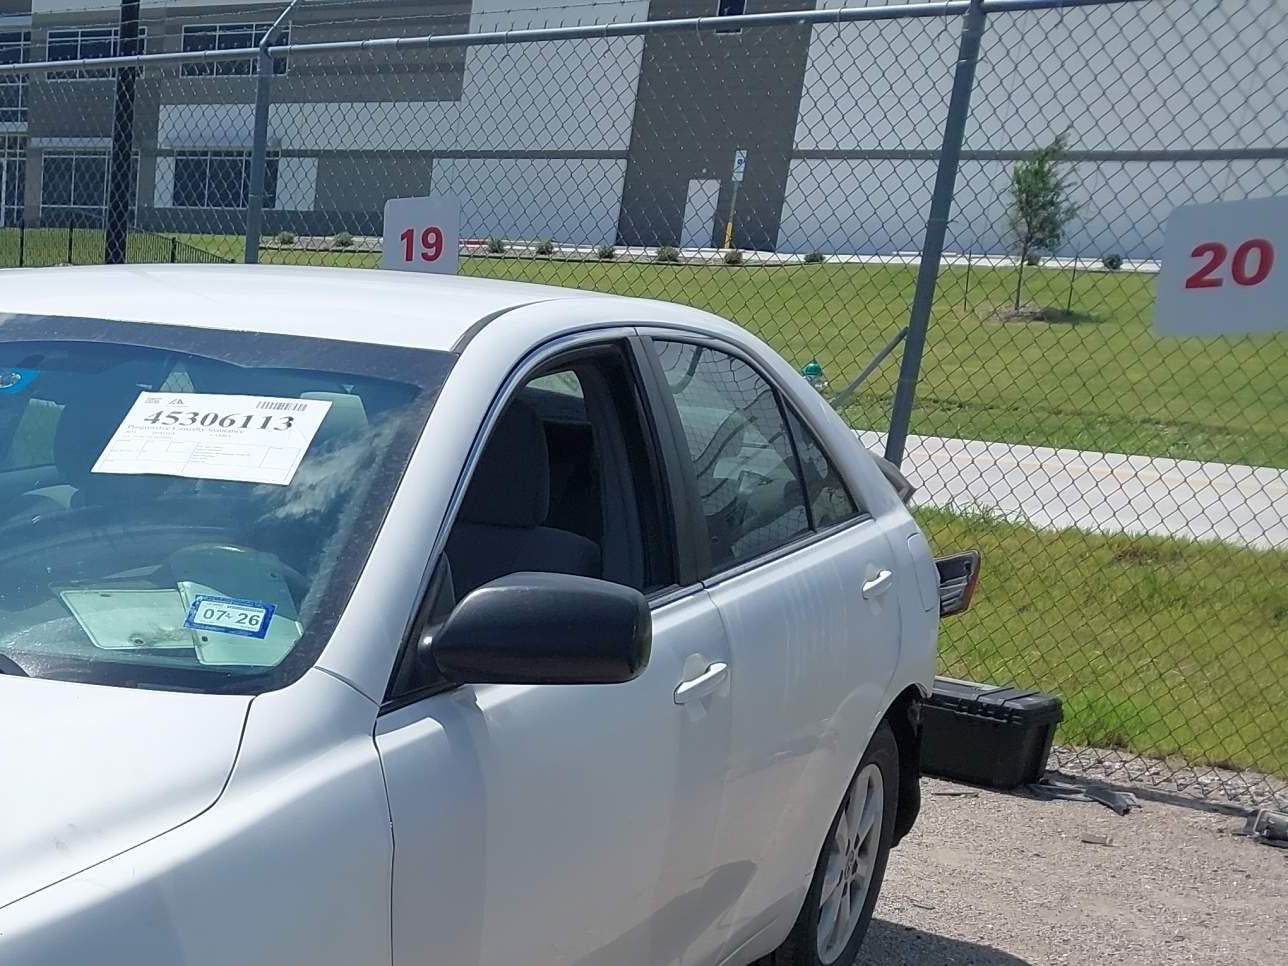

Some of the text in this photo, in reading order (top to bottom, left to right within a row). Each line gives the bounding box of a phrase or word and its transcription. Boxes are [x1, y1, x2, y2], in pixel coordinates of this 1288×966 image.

[400, 226, 444, 262] 19
[1184, 238, 1275, 289] 20
[144, 410, 295, 432] 45306113
[203, 608, 227, 621] 07
[235, 612, 261, 626] 26
